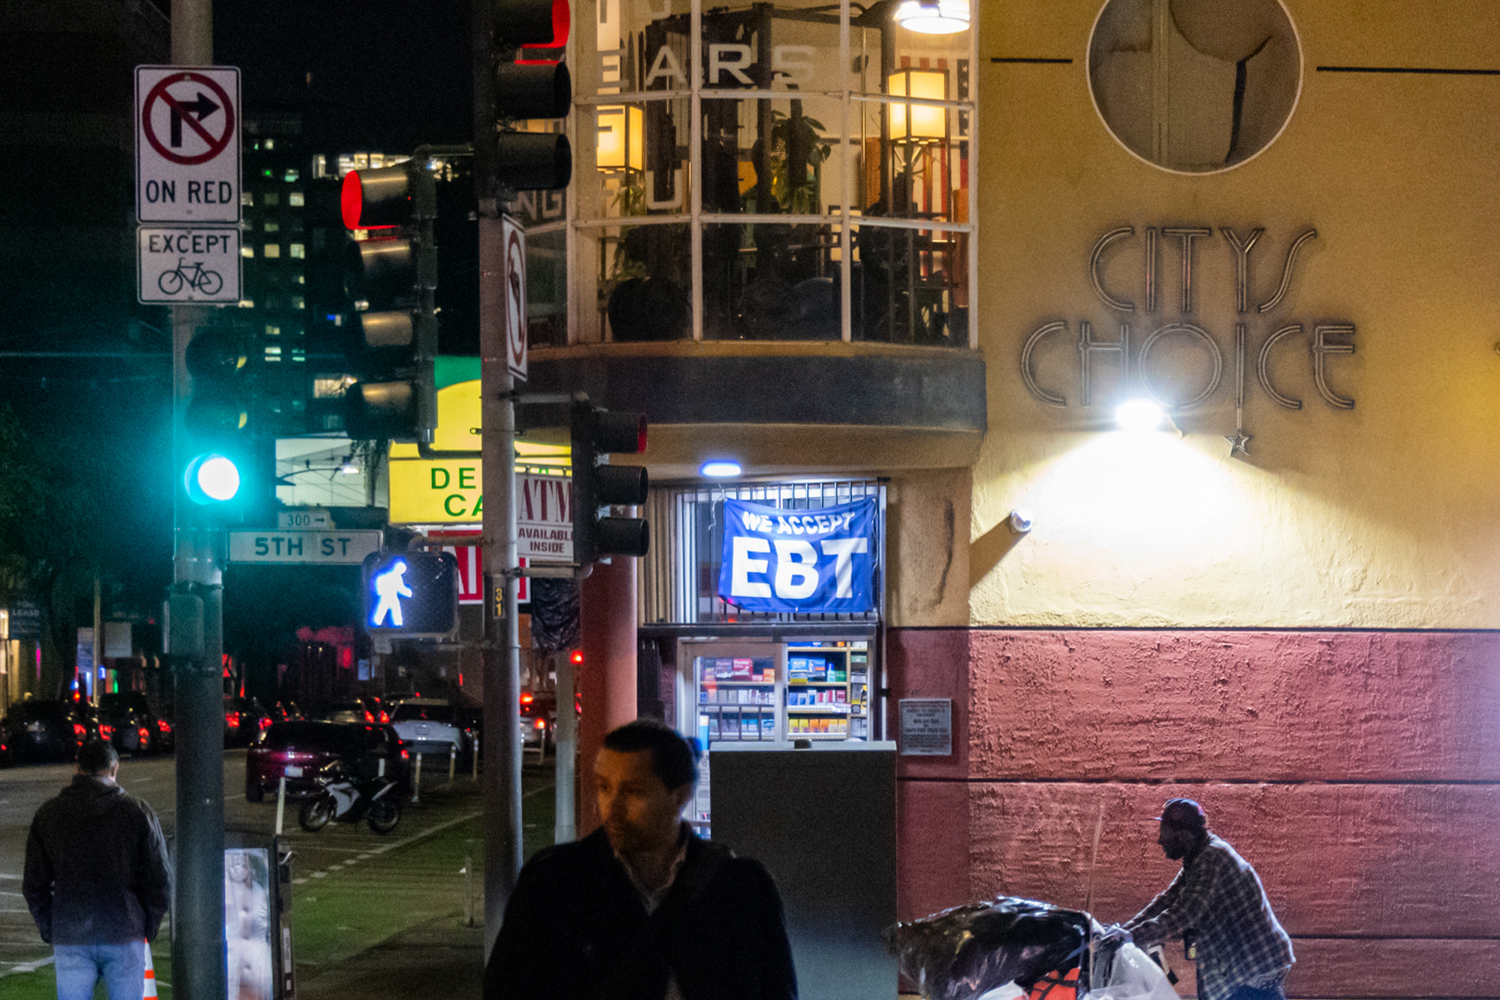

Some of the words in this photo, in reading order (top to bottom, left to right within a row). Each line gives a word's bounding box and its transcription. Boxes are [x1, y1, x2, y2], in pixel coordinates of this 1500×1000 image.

[597, 43, 816, 88] EARS
[146, 181, 175, 203] ON
[188, 181, 232, 204] RED
[149, 235, 231, 254] EXCEPT
[1088, 226, 1317, 312] CITYS
[1021, 321, 1355, 409] CHOICE
[519, 479, 573, 523] ATM
[287, 515, 311, 527] 300
[742, 511, 773, 532] WE
[777, 511, 856, 535] ACCEPT
[254, 537, 303, 556] 5TH
[320, 537, 352, 556] ST
[518, 528, 573, 542] AVAILABL
[529, 541, 565, 553] INSIDE
[731, 536, 868, 600] EBT
[495, 587, 503, 616] 31
